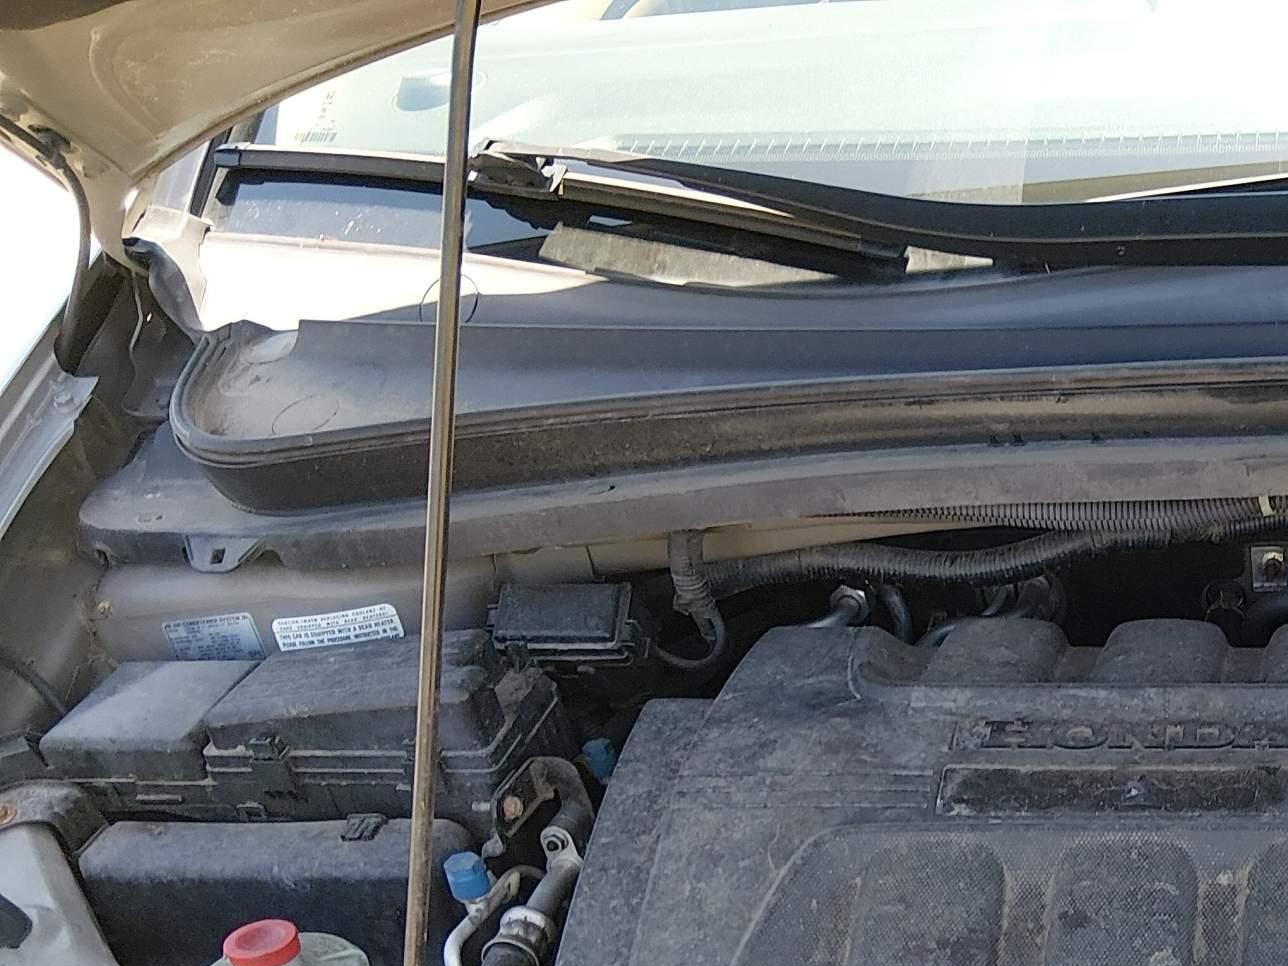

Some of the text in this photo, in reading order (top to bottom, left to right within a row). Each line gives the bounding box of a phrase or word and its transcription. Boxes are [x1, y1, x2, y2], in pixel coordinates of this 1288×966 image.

[279, 633, 291, 641] THIS
[310, 628, 336, 638] EQUIPPED
[337, 626, 351, 634] WITH
[359, 621, 373, 631] REAR
